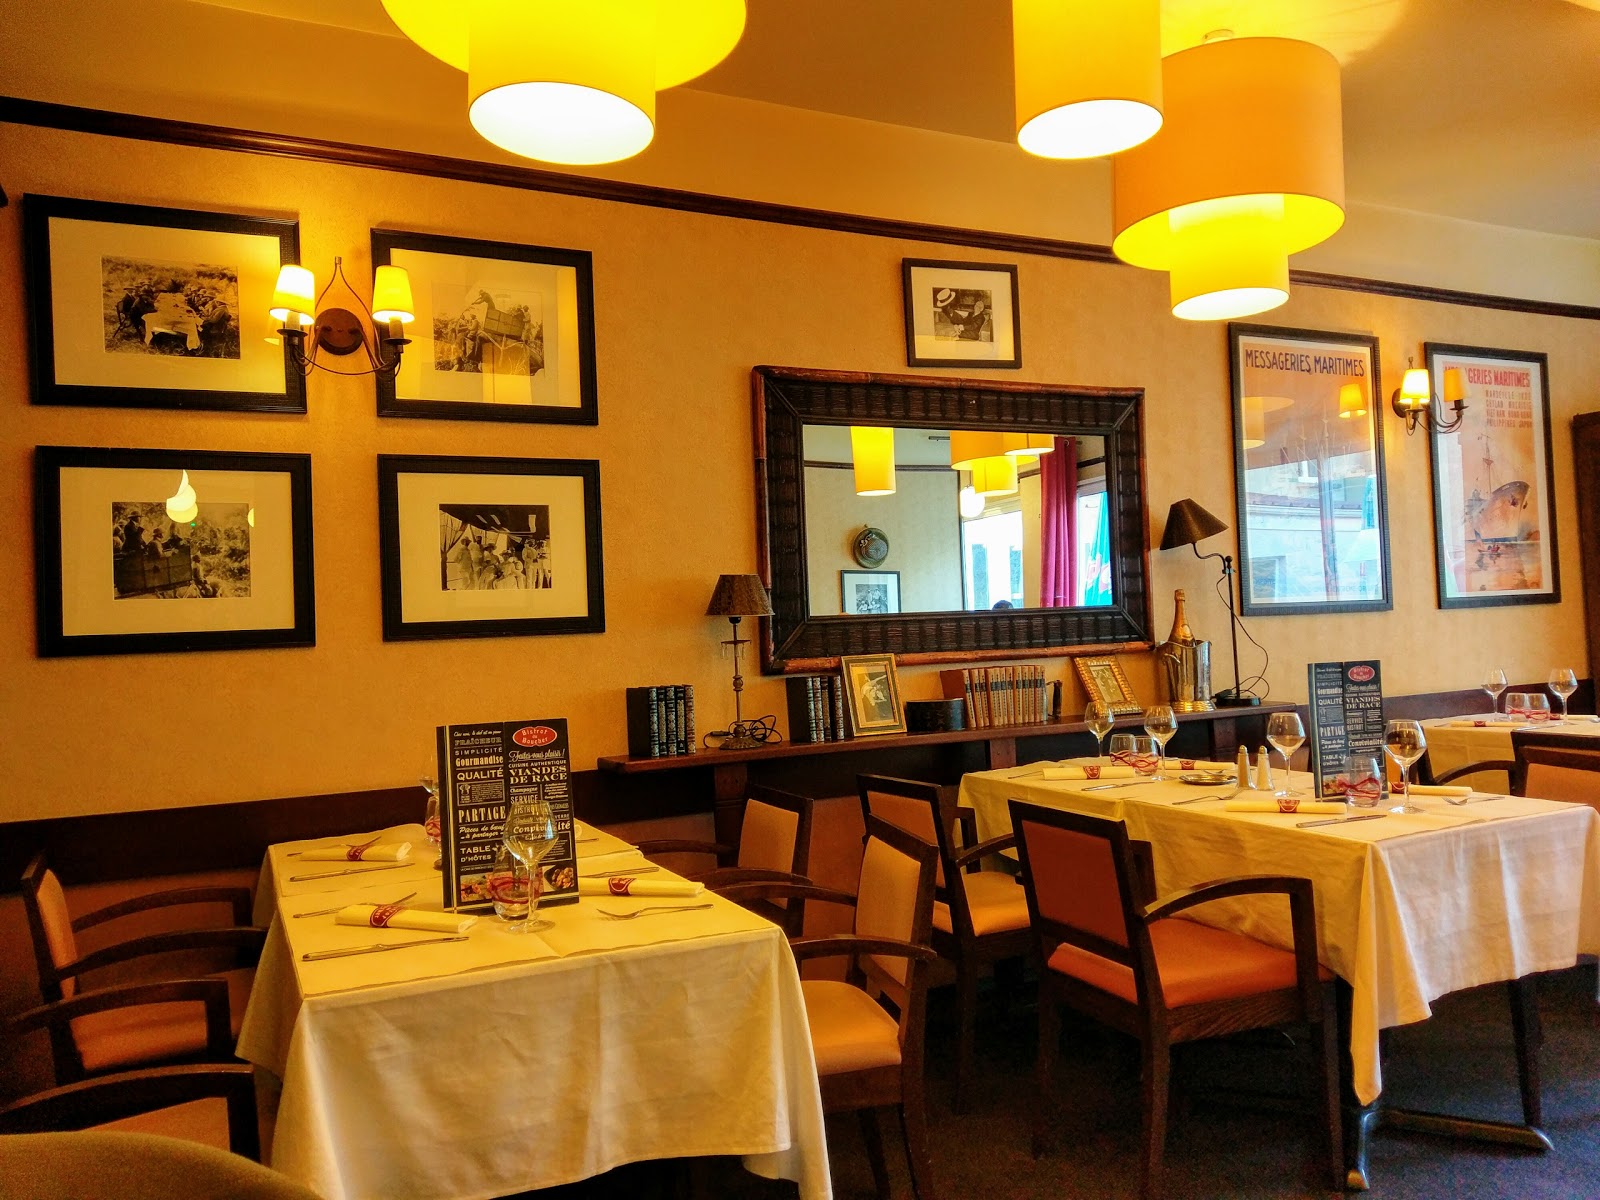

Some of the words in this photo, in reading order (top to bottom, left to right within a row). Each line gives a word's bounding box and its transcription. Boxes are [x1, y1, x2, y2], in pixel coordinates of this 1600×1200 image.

[1245, 349, 1311, 373] MESSAGERIES
[1314, 356, 1365, 377] MARITIMES
[1494, 370, 1530, 387] MARITIMES
[1318, 697, 1343, 706] QUALITÉ
[522, 728, 548, 736] Bistrot
[1320, 726, 1345, 737] PARTAGE
[455, 747, 503, 756] SIMPLICITÉ
[455, 755, 504, 767] Gourmandise
[457, 768, 504, 781] QUALITÉ
[509, 765, 567, 776] VIANDES
[510, 775, 528, 784] DE
[532, 772, 567, 782] RACE
[510, 795, 538, 805] SERVICE
[458, 806, 506, 823] PARTAGE
[460, 845, 491, 854] TABLE
[460, 854, 492, 863] D'HÔTES
